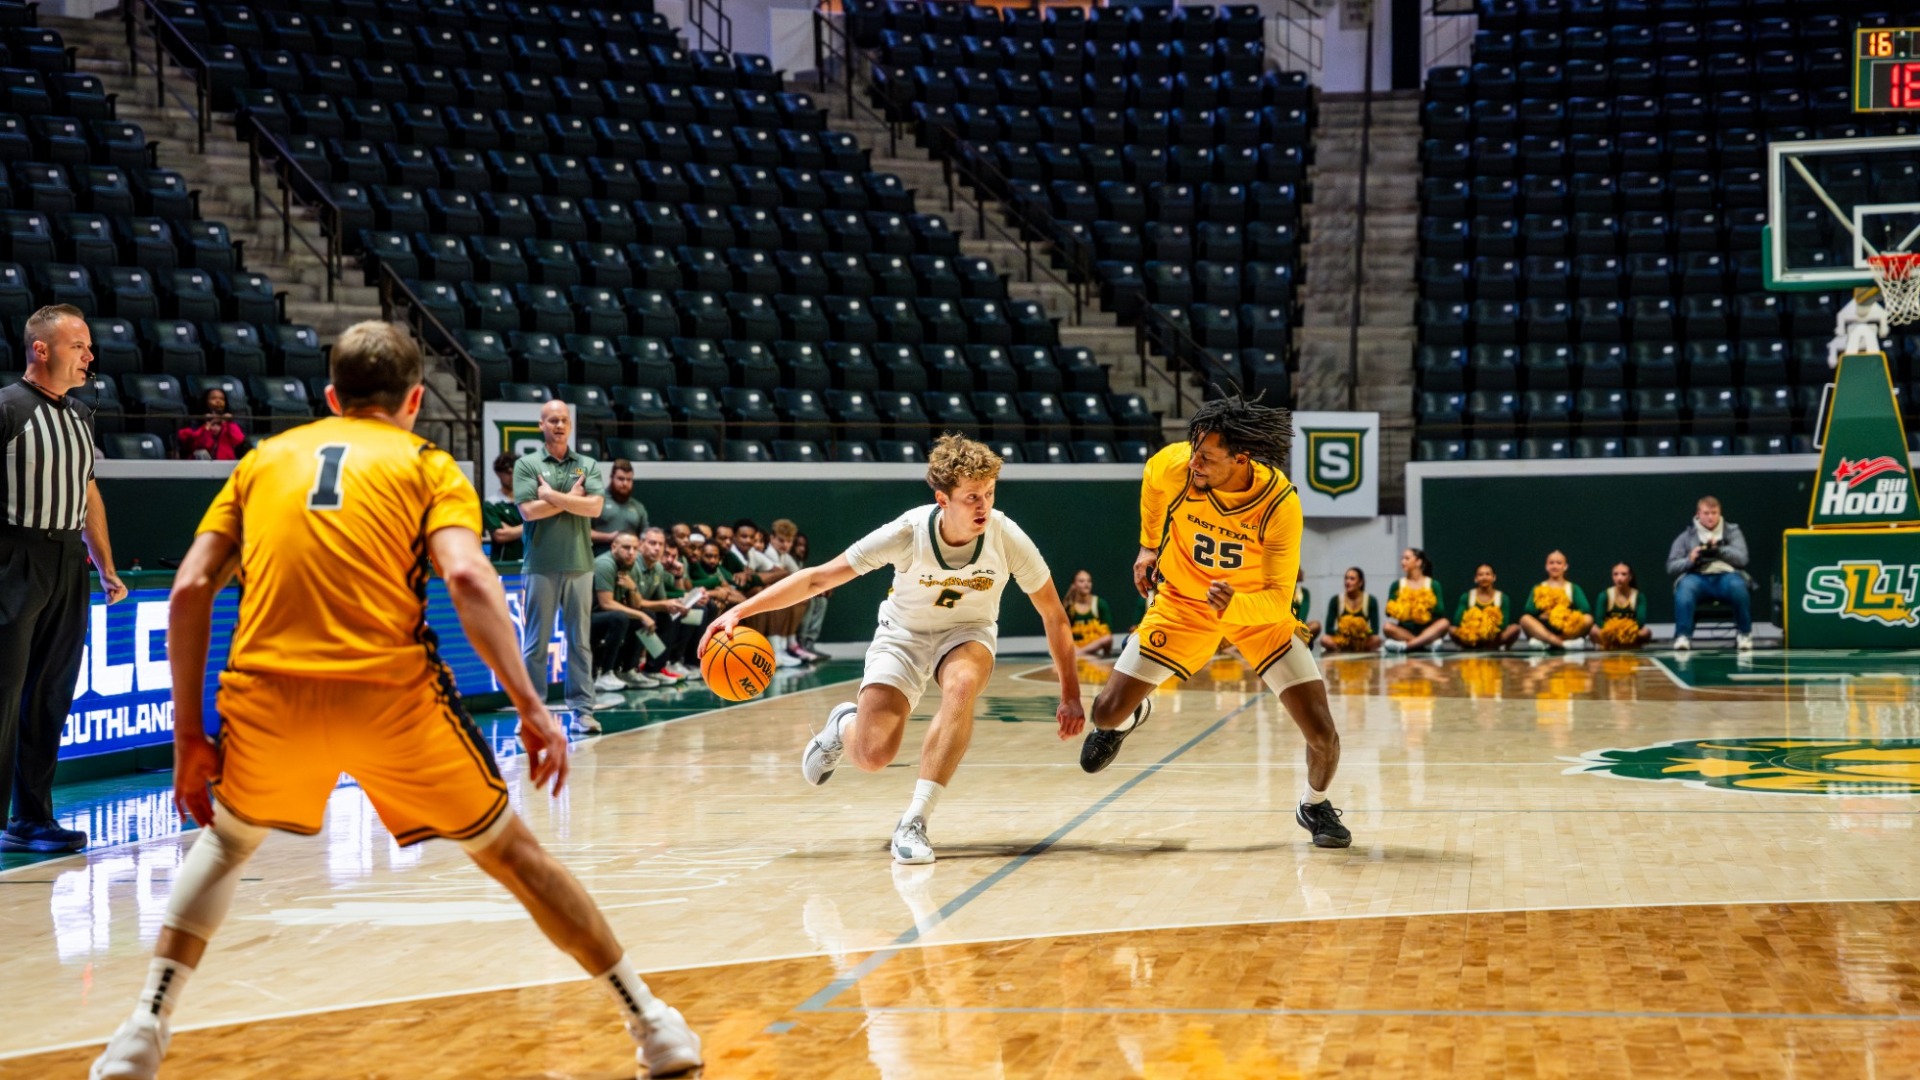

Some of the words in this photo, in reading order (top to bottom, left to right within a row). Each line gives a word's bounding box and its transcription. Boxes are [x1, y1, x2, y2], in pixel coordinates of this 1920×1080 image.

[1869, 32, 1893, 57] 16
[307, 443, 352, 510] 1
[1319, 442, 1350, 479] S
[1877, 479, 1908, 493] Bill
[1187, 514, 1216, 531] EAST
[1193, 533, 1244, 569] 25
[73, 601, 173, 701] LC
[59, 700, 175, 747] OUTHLAND
